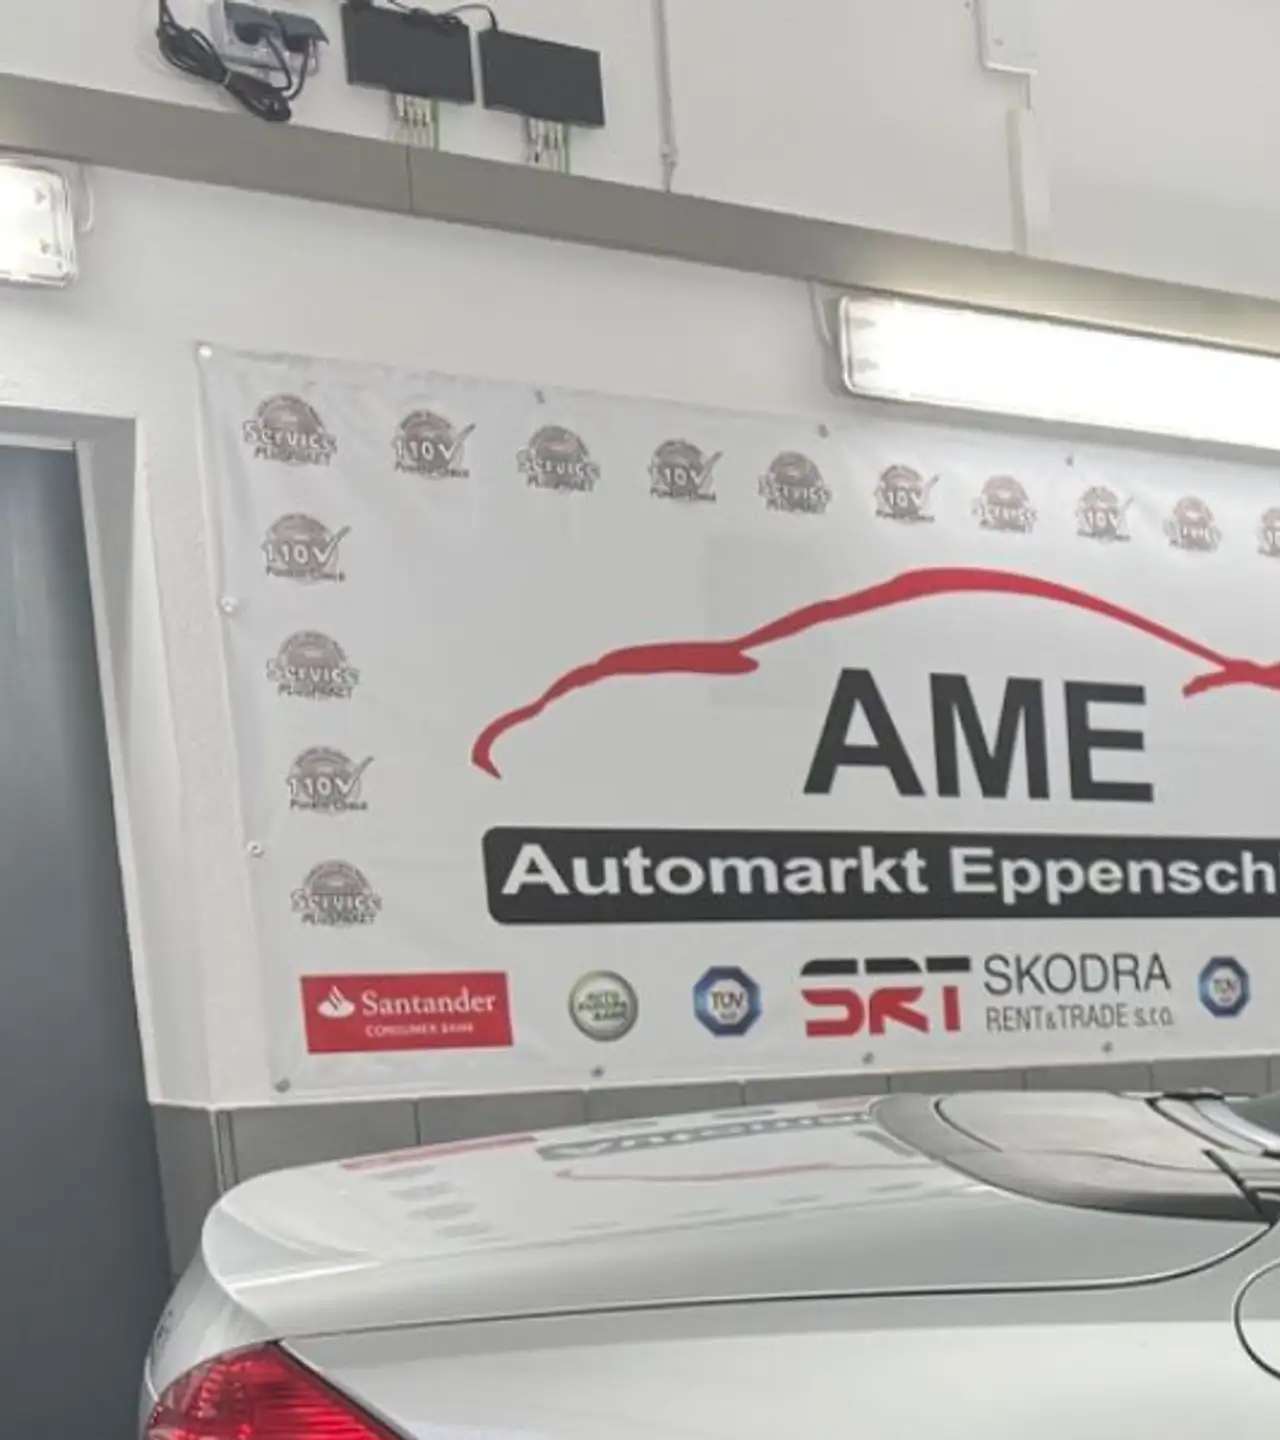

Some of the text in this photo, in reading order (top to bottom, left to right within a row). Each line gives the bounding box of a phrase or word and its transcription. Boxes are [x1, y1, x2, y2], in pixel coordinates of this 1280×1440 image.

[803, 667, 1154, 802] AME
[502, 843, 930, 896] Automarkt
[983, 951, 1172, 997] SKODRA
[361, 985, 496, 1018] Santander
